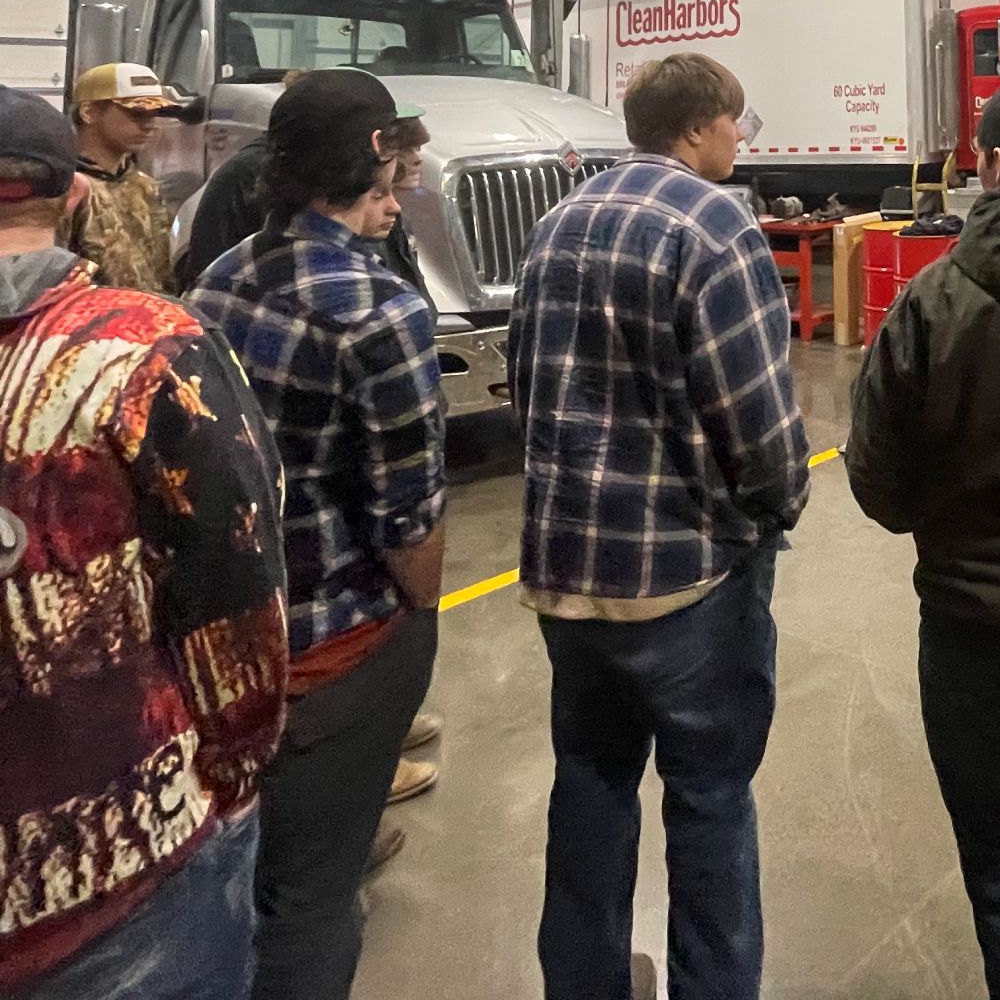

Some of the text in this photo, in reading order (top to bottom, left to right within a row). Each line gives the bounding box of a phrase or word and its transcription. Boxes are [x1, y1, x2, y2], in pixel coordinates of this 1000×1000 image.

[616, 62, 642, 77] Reta
[833, 82, 885, 98] 60 Cubic Yard
[846, 100, 879, 115] Capacity
